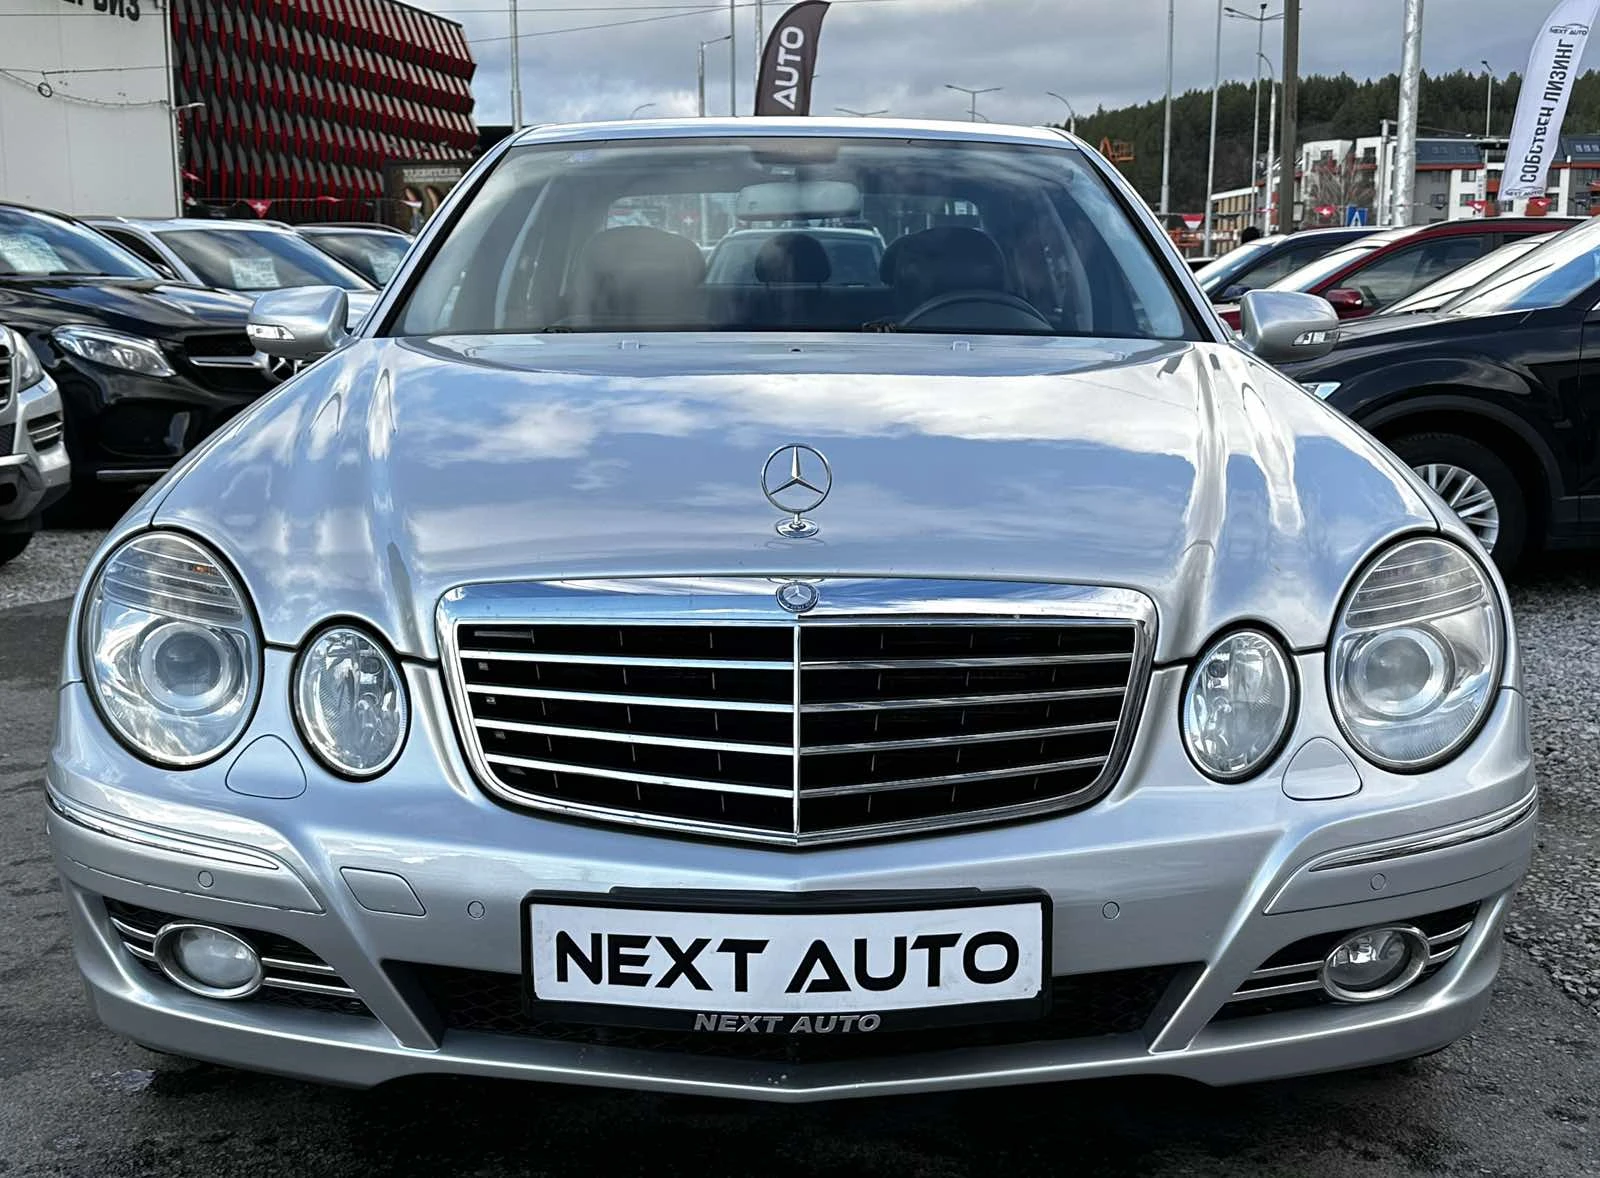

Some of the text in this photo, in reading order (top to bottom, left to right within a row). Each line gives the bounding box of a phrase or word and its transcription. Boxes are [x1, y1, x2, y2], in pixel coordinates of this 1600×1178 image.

[773, 26, 804, 111] AUTO
[1520, 39, 1574, 183] СОБСТВЕН ЛИЗИНГ
[555, 930, 1020, 993] NEXT AUTO
[693, 1013, 881, 1033] NEXT AUTO
